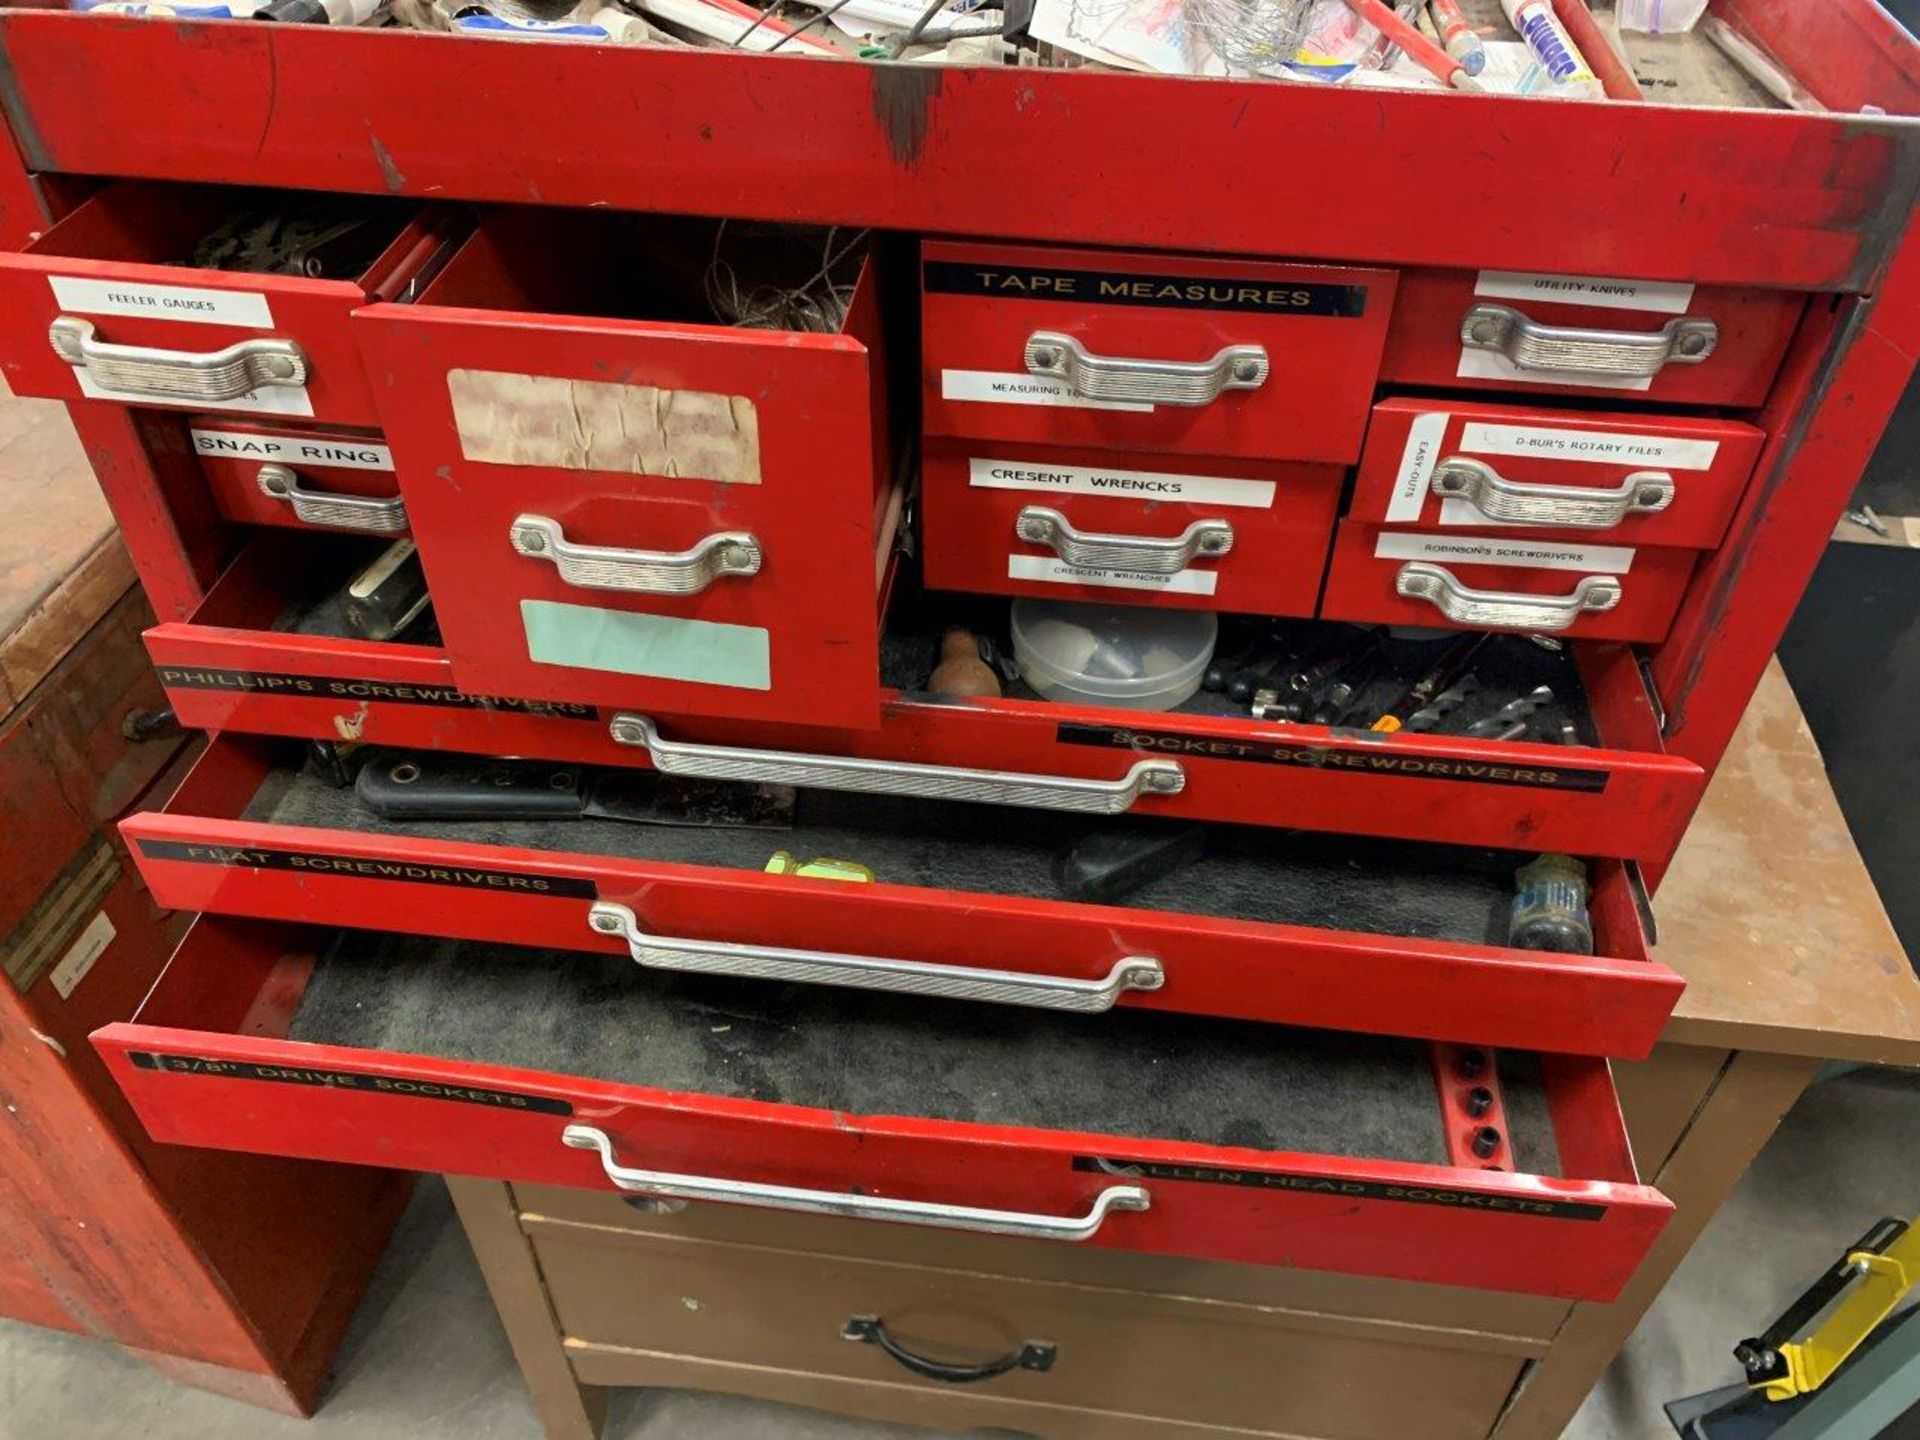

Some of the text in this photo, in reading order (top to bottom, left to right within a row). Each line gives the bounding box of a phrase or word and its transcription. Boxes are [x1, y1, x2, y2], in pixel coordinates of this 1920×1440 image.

[975, 272, 1312, 307] TAPE MEASURES
[1533, 279, 1636, 297] UTILITY KNIVES
[108, 293, 216, 312] FEELER GAUGES
[992, 382, 1060, 396] MEASURING
[198, 437, 381, 464] SNAP RING
[1570, 441, 1623, 453] ROTARY
[1628, 445, 1663, 457] FILES
[991, 468, 1183, 494] CRESENT WRENCKS
[1424, 543, 1585, 561] ROBINSON'S SCREWDRIVERS
[1054, 566, 1108, 578] CRESCENT
[162, 670, 589, 714] PHILLIP'S SCREWDRIVERS
[1110, 731, 1560, 784] SOCKET SCREWDRIVERS
[289, 856, 552, 891] SCREWDRIVERS
[254, 1066, 356, 1085] DRIVE
[375, 1079, 528, 1107] SOCKETS
[1262, 1176, 1366, 1192] HEAD
[1385, 1188, 1554, 1213] SOCKETS
